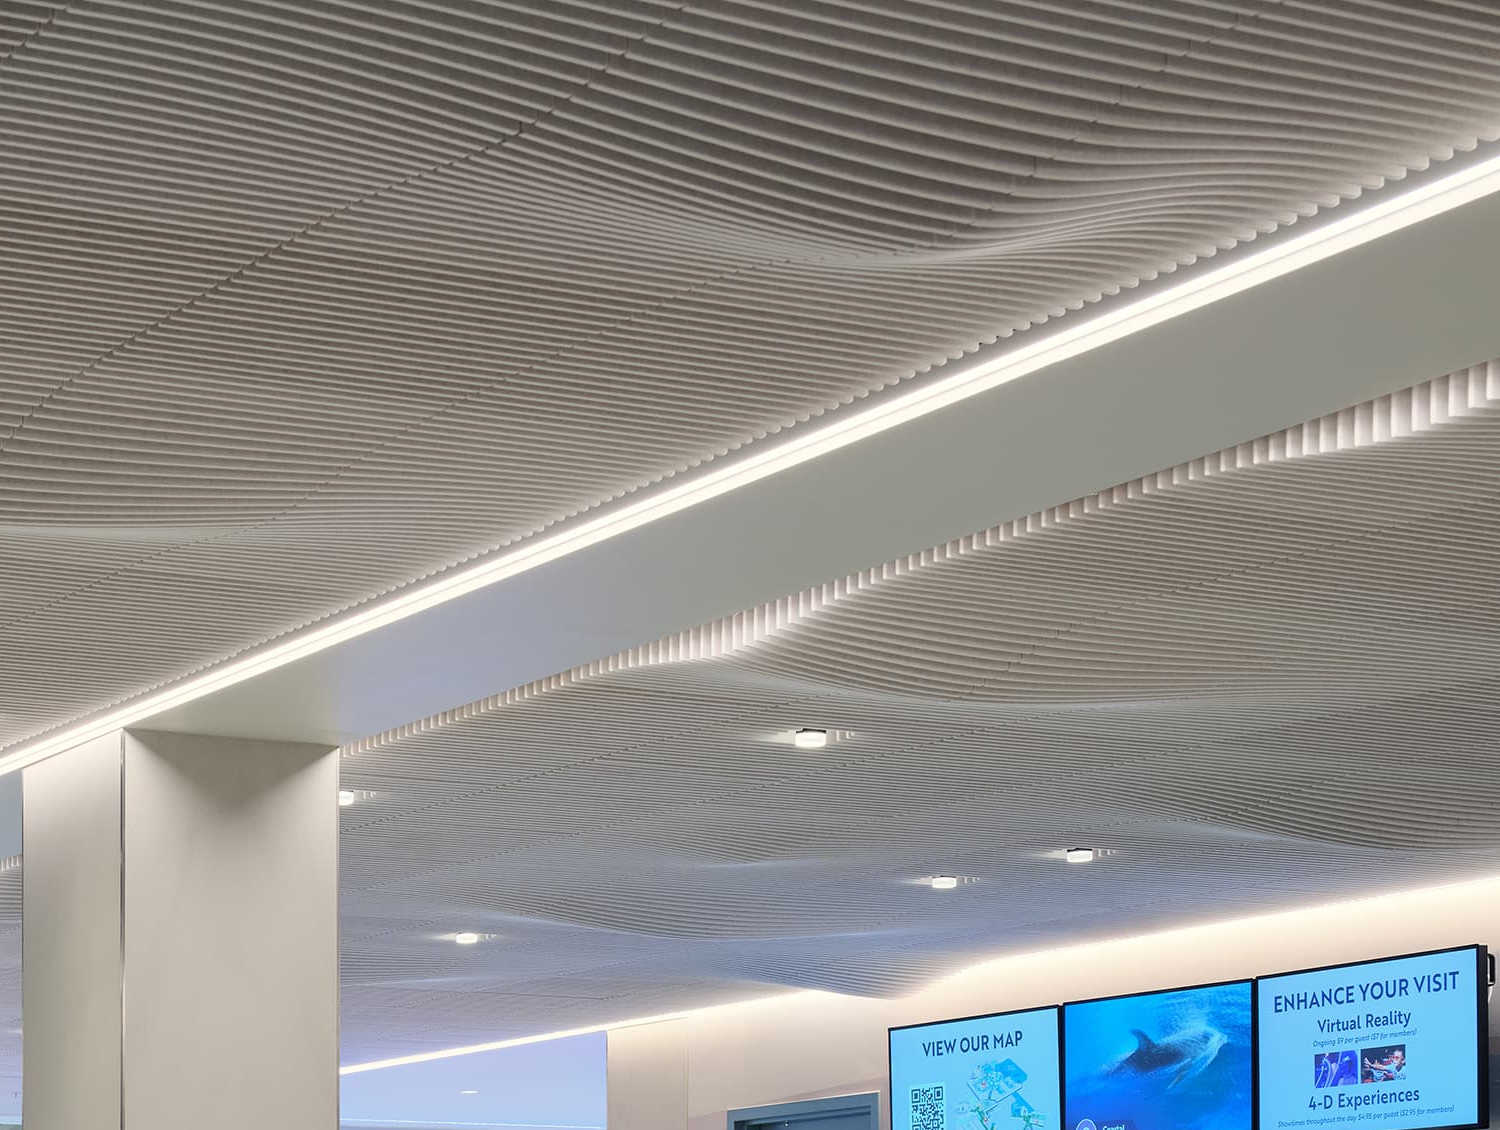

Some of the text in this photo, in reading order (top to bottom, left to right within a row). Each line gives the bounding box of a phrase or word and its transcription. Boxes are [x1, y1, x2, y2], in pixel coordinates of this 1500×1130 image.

[1274, 971, 1460, 1013] ENHANCE YOUR VISIT
[1317, 1010, 1412, 1033] Virtual Reality
[922, 1030, 1023, 1056] VIEW OUR MAP
[1313, 1039, 1336, 1048] Ongoing
[1355, 1034, 1370, 1043] guest
[1380, 1032, 1389, 1041] for
[1389, 1028, 1418, 1039] members)
[1308, 1089, 1420, 1111] 4-D Experiences
[1277, 1118, 1305, 1128] Showtimes
[1306, 1115, 1336, 1126] throughout
[1337, 1114, 1346, 1123] the
[1347, 1114, 1357, 1124] day
[1373, 1111, 1383, 1121] per
[1384, 1109, 1399, 1119] guest
[1416, 1106, 1426, 1117] for
